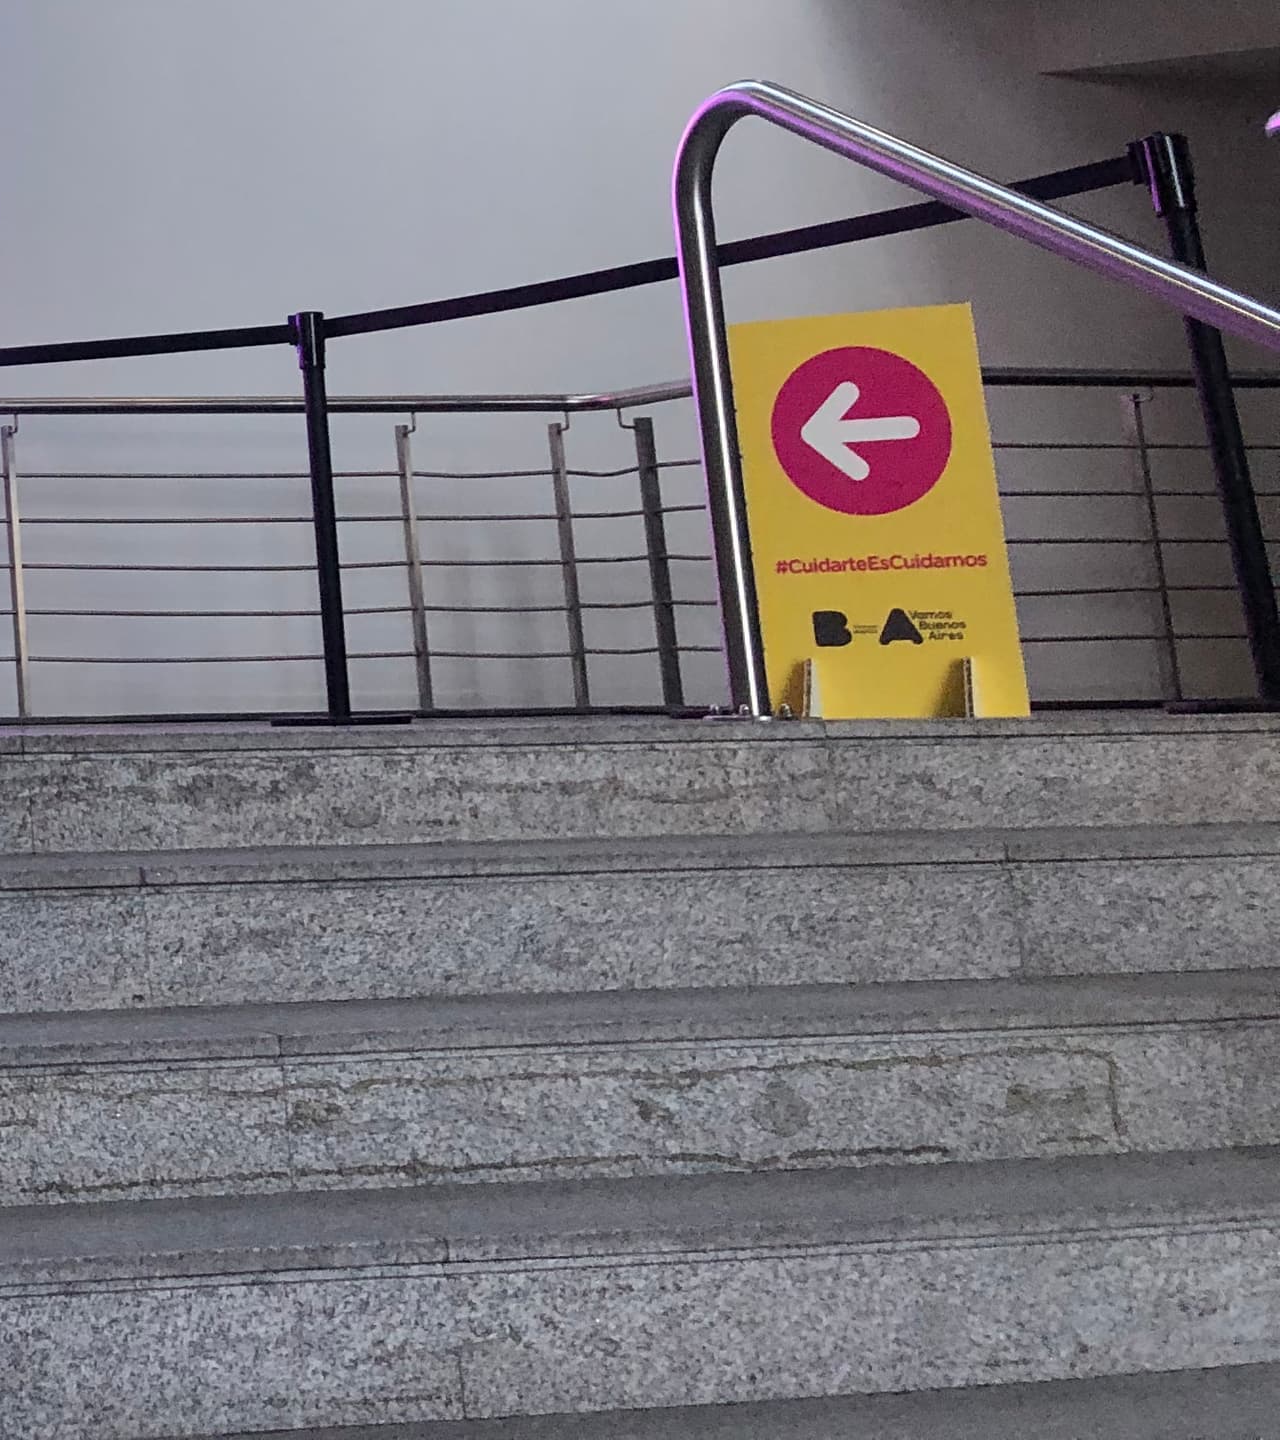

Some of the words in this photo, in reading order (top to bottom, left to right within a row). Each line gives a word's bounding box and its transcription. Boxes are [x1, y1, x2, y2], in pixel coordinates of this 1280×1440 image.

[776, 553, 988, 575] #CuidarteEsCuidamos
[919, 620, 966, 630] Buenos
[928, 631, 964, 641] Aires
